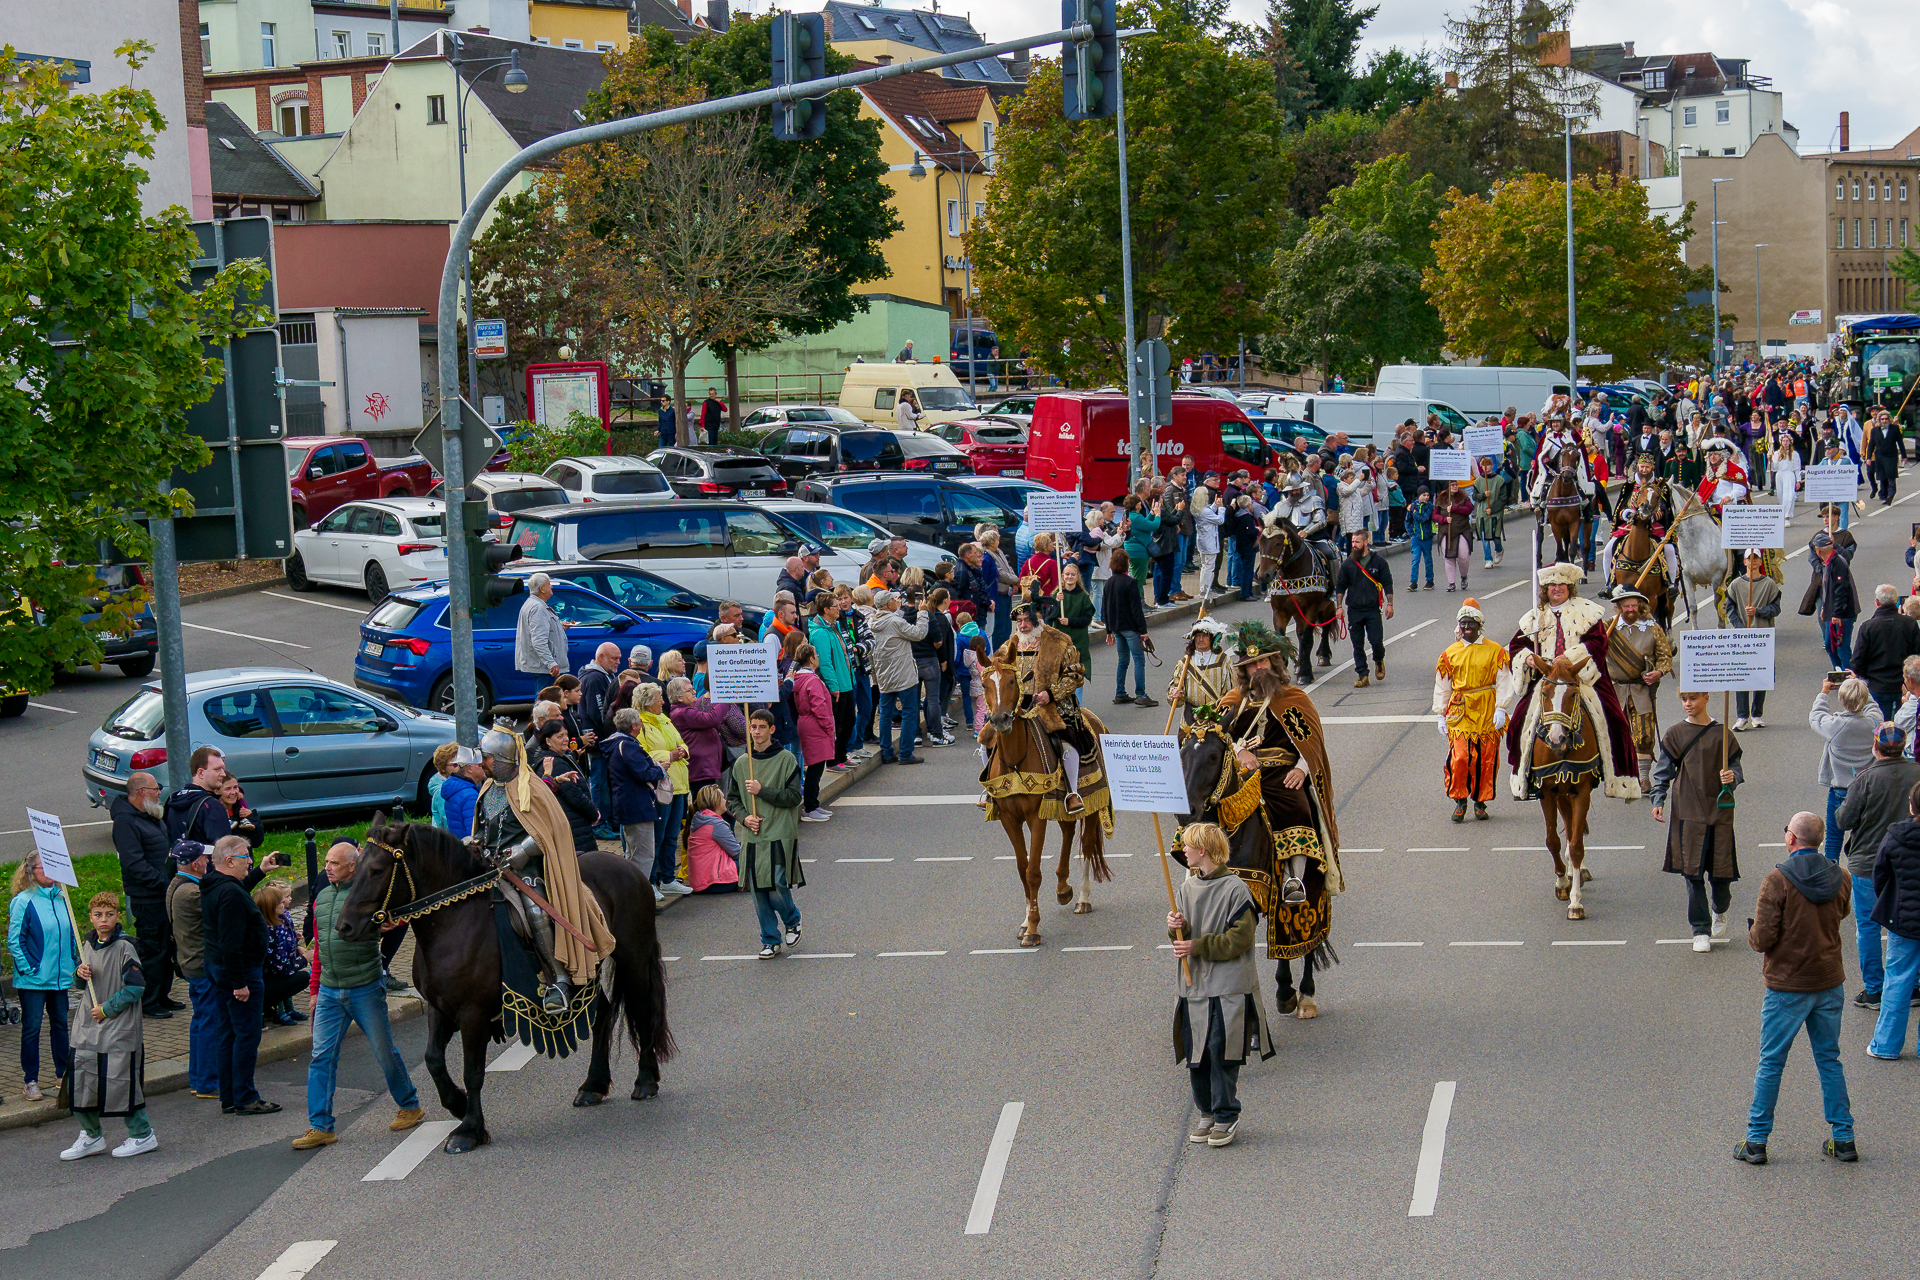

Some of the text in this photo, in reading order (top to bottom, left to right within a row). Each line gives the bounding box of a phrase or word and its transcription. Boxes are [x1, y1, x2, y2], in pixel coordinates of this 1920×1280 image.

[1104, 740, 1130, 748] Heinrich
[1144, 741, 1174, 749] Erlauchte
[1113, 753, 1136, 761] Markgraf
